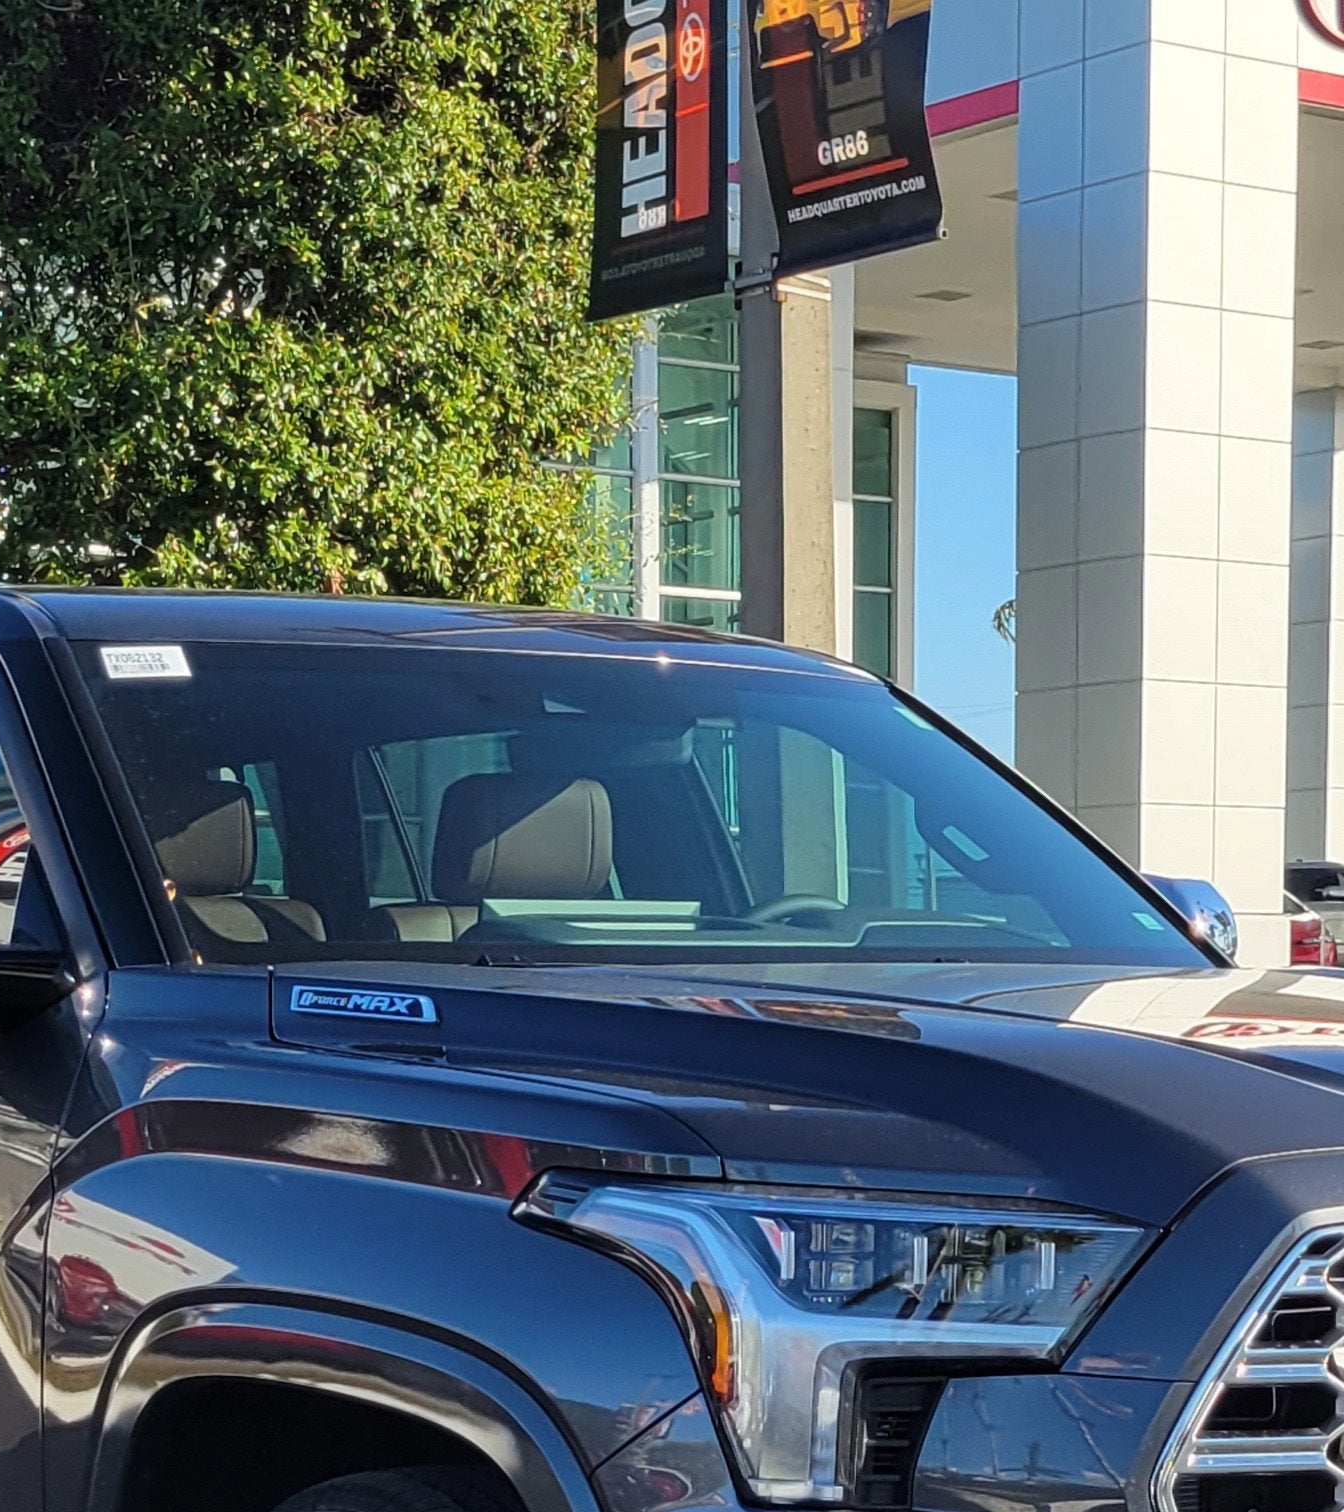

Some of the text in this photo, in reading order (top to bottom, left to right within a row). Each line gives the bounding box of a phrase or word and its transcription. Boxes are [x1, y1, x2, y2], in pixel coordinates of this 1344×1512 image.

[818, 131, 870, 166] GR86
[787, 175, 926, 223] HEADQUARTERTOYOTA.COM
[347, 995, 414, 1014] MAX
